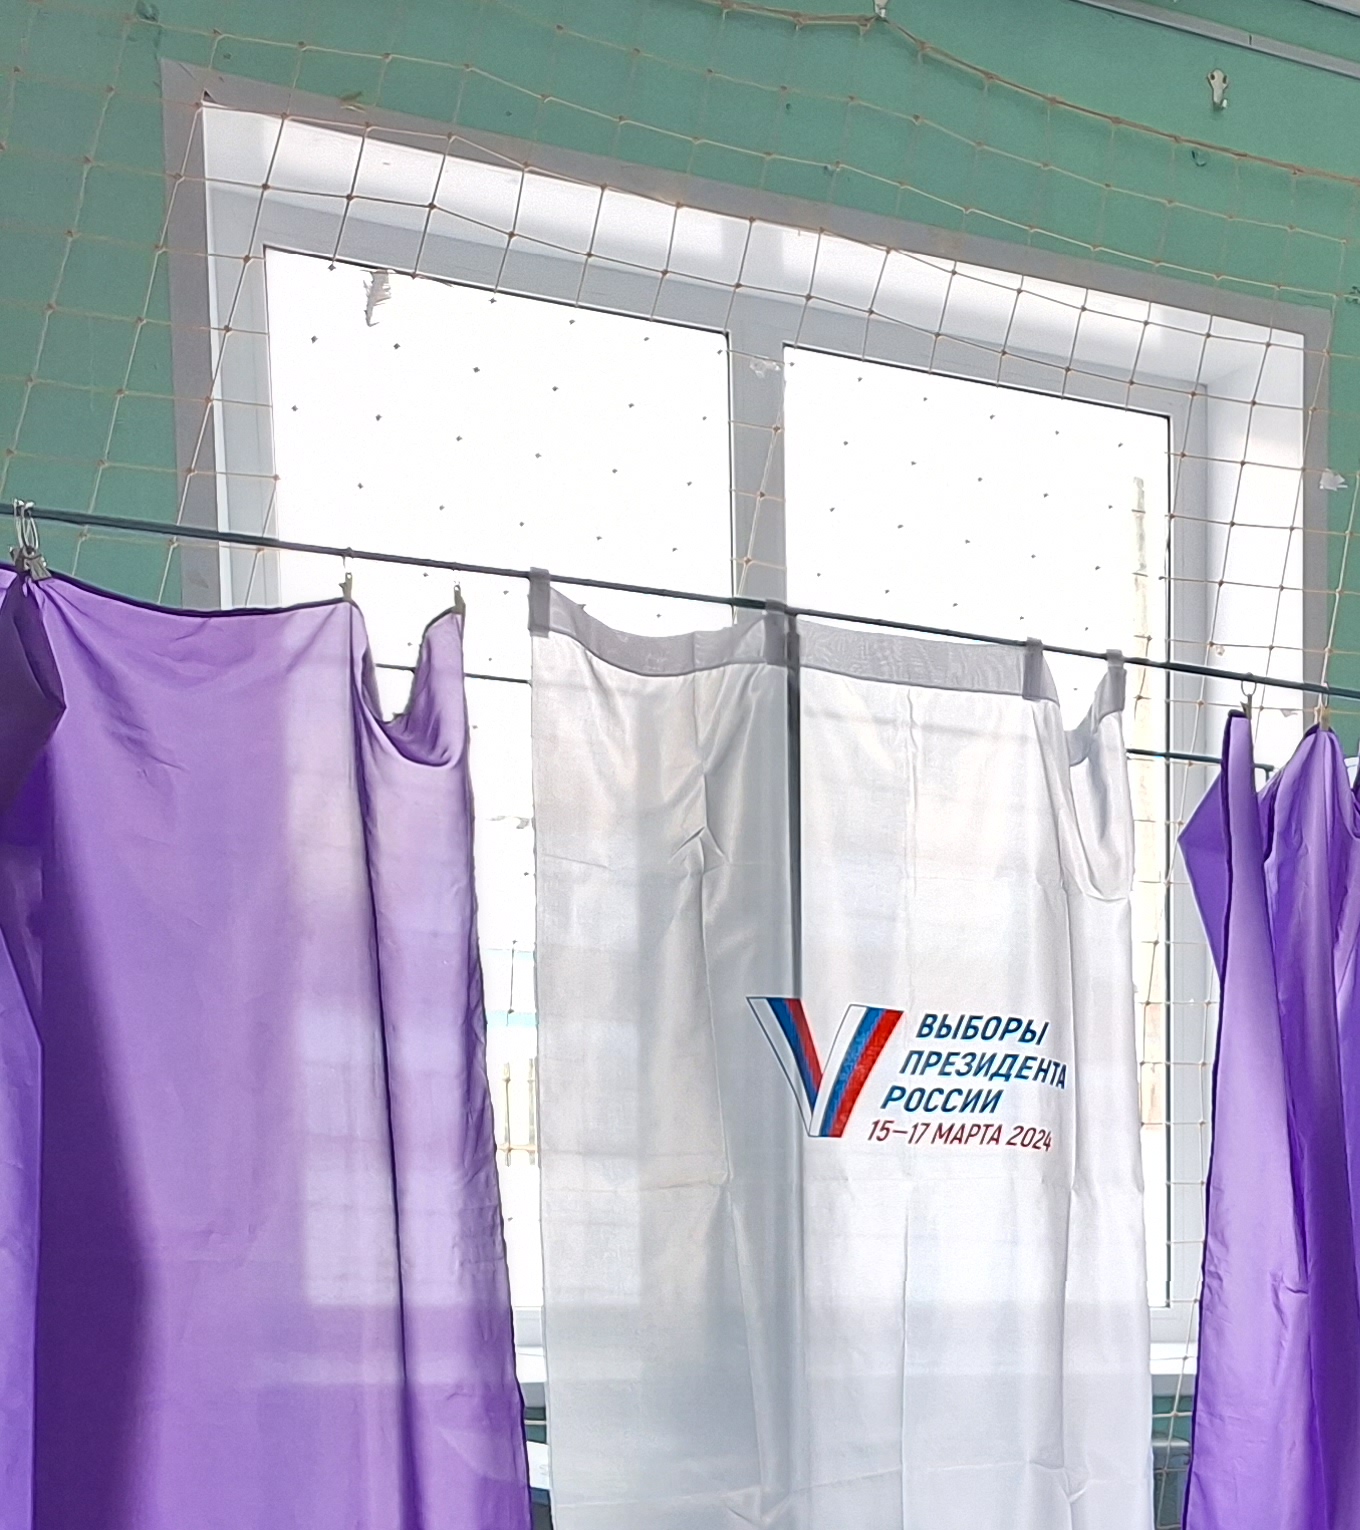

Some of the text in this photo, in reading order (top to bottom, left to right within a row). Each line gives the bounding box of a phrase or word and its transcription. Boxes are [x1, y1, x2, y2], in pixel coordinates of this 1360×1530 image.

[915, 1013, 1050, 1046] ВЫБОРЫ
[899, 1050, 1067, 1090] ПРЕЗИДЕНТА
[880, 1085, 1004, 1114] РОССИИ
[931, 1123, 1003, 1145] МАРТА
[1005, 1125, 1052, 1152] 2024
